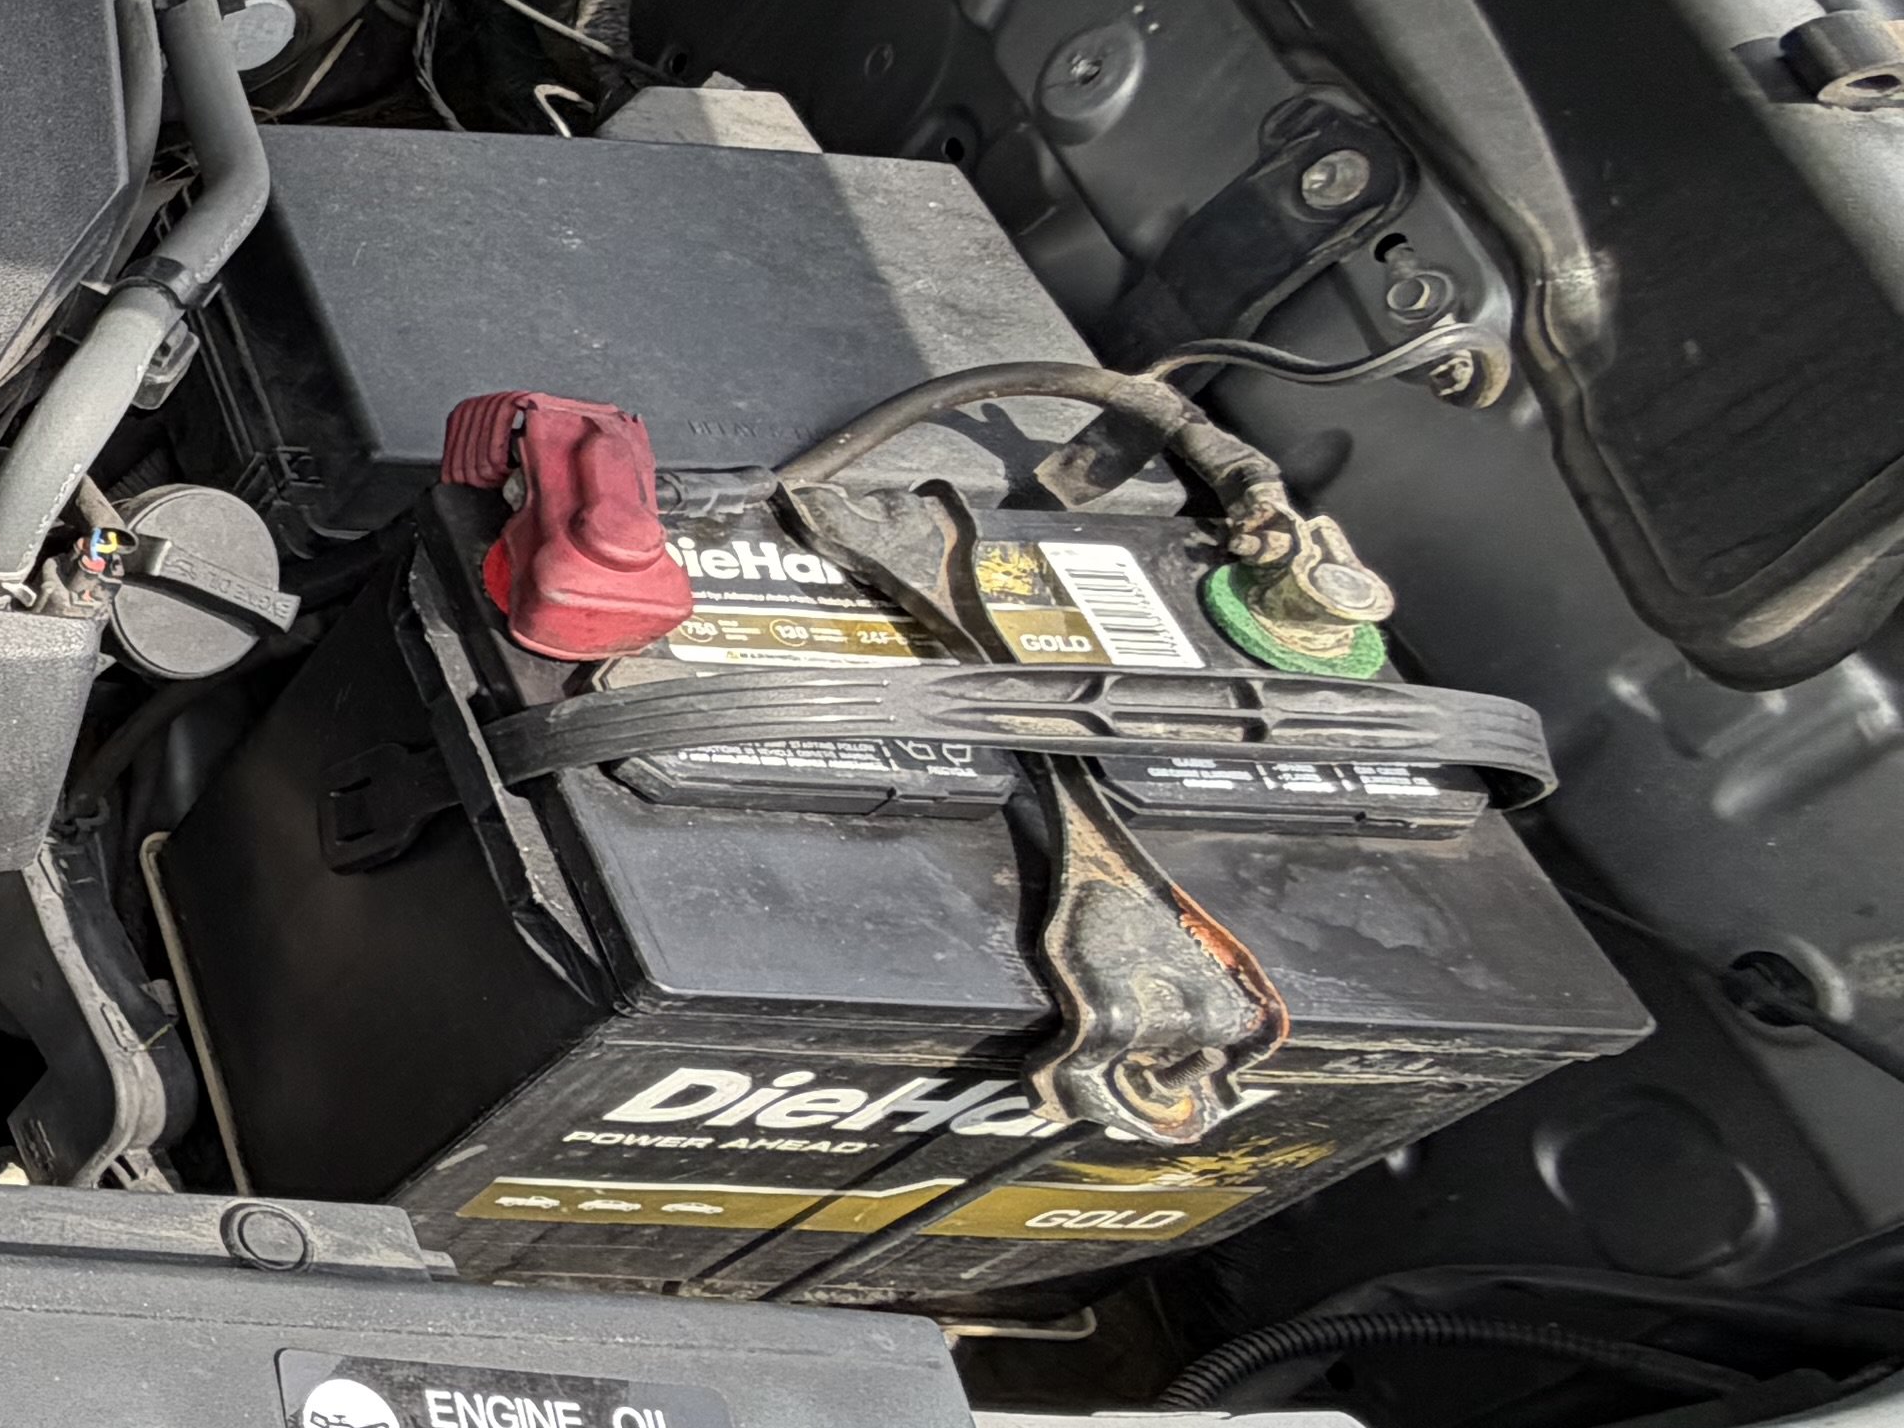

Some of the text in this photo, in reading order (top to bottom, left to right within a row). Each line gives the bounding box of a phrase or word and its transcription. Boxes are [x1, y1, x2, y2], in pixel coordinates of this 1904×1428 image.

[1019, 632, 1092, 653] GOLD
[562, 1130, 869, 1156] POWER AHEAD
[1024, 1208, 1189, 1231] GOLD
